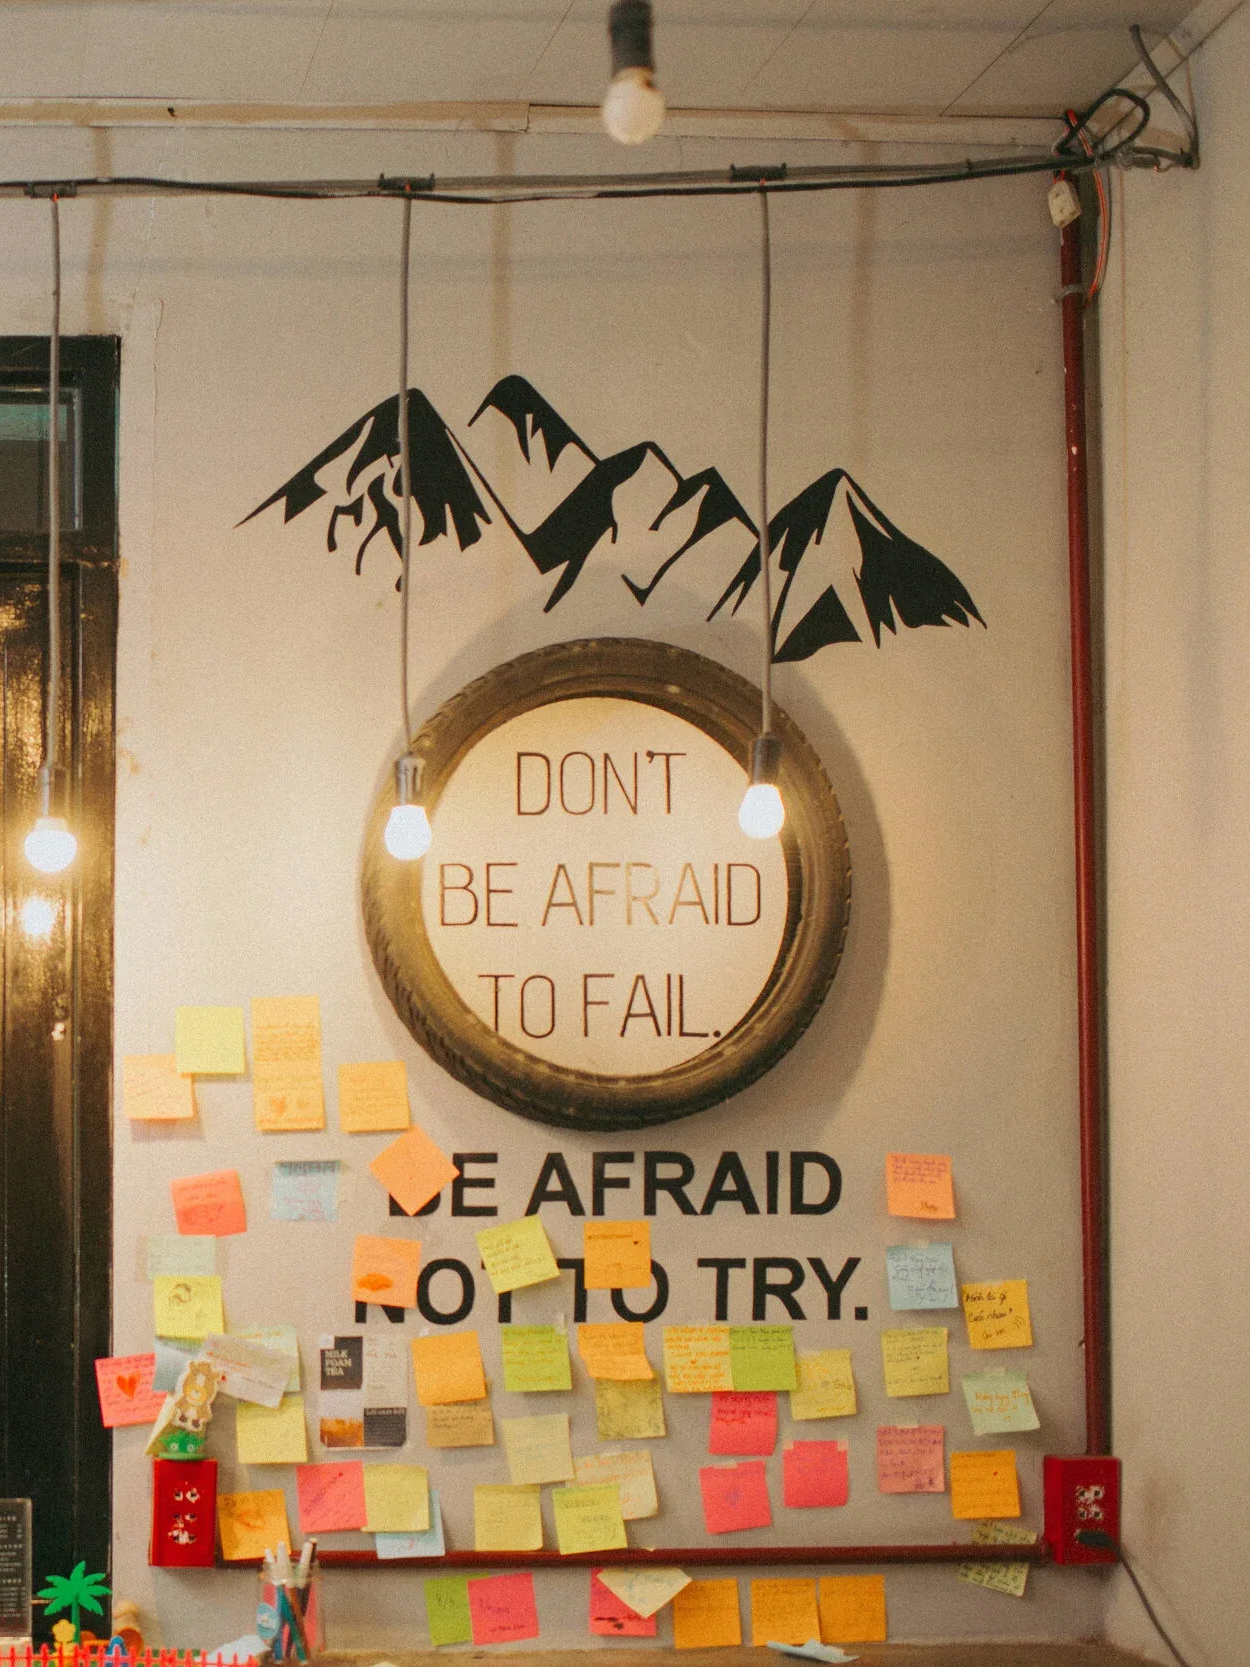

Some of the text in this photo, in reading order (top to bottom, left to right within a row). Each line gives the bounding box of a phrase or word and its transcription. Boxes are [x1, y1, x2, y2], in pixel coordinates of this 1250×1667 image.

[516, 751, 687, 816] DON'T
[439, 862, 762, 928] BE AFRAID
[477, 973, 723, 1039] TO FAIL.
[524, 1150, 843, 1216] AFRAID
[696, 1256, 869, 1322] TRY.
